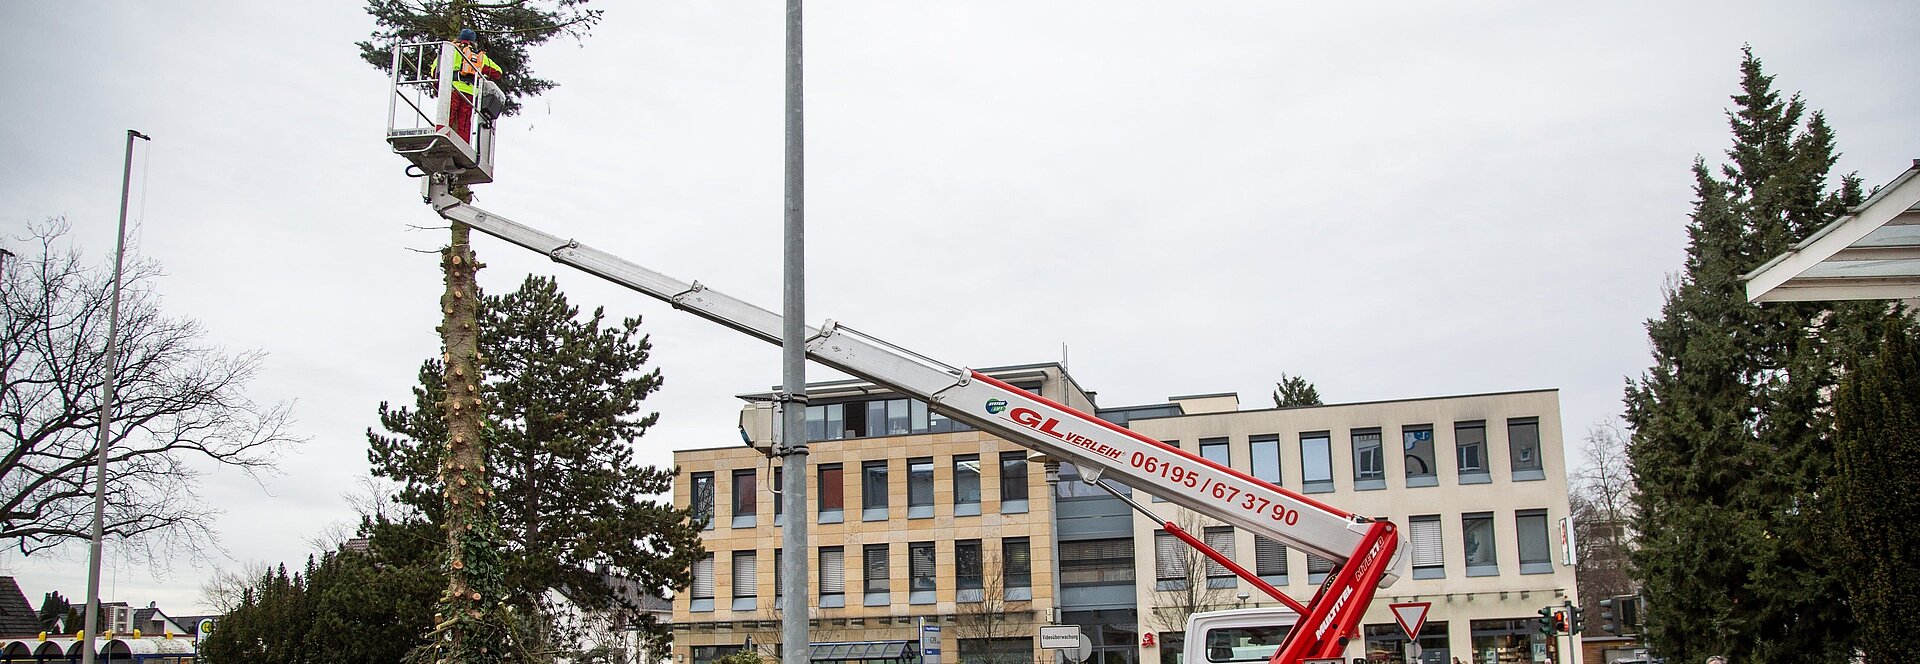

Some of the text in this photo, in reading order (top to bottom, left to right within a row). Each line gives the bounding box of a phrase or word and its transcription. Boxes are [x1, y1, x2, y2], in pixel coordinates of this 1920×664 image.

[1009, 407, 1065, 438] GL
[1130, 451, 1199, 488] 06195
[1315, 584, 1353, 640] MULTITEL
